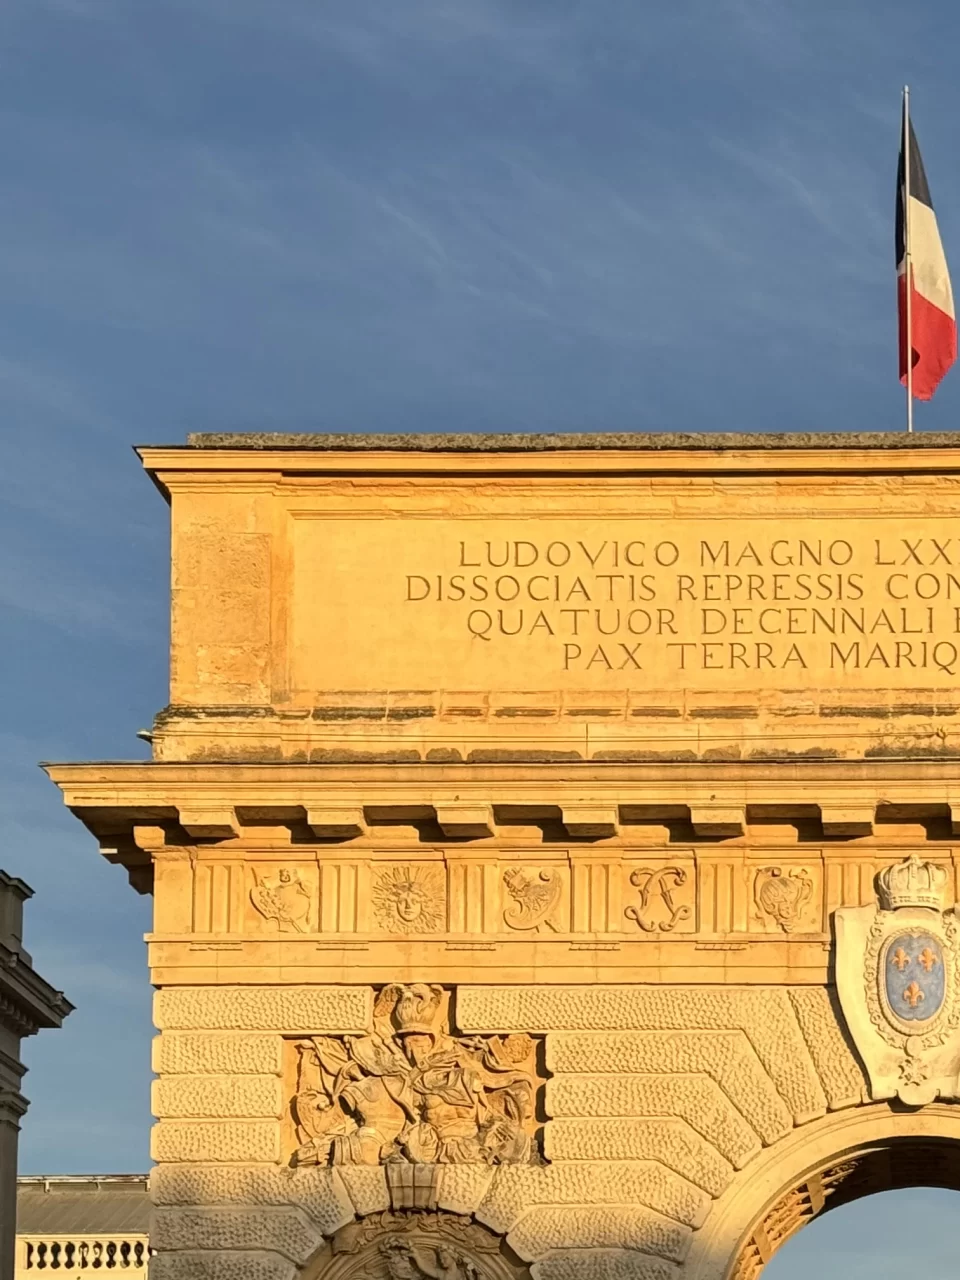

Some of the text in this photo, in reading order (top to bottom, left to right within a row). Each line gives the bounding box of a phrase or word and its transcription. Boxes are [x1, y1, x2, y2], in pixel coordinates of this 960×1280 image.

[459, 541, 679, 569] LUDOVICO
[700, 540, 853, 568] MAGNO
[405, 575, 656, 601] DISSOCIATIS
[677, 574, 864, 601] REPRESSIS
[467, 609, 678, 640] QUATUOR
[701, 607, 934, 635] DECENNALI
[563, 643, 642, 670] PAX
[667, 643, 808, 669] TERRA
